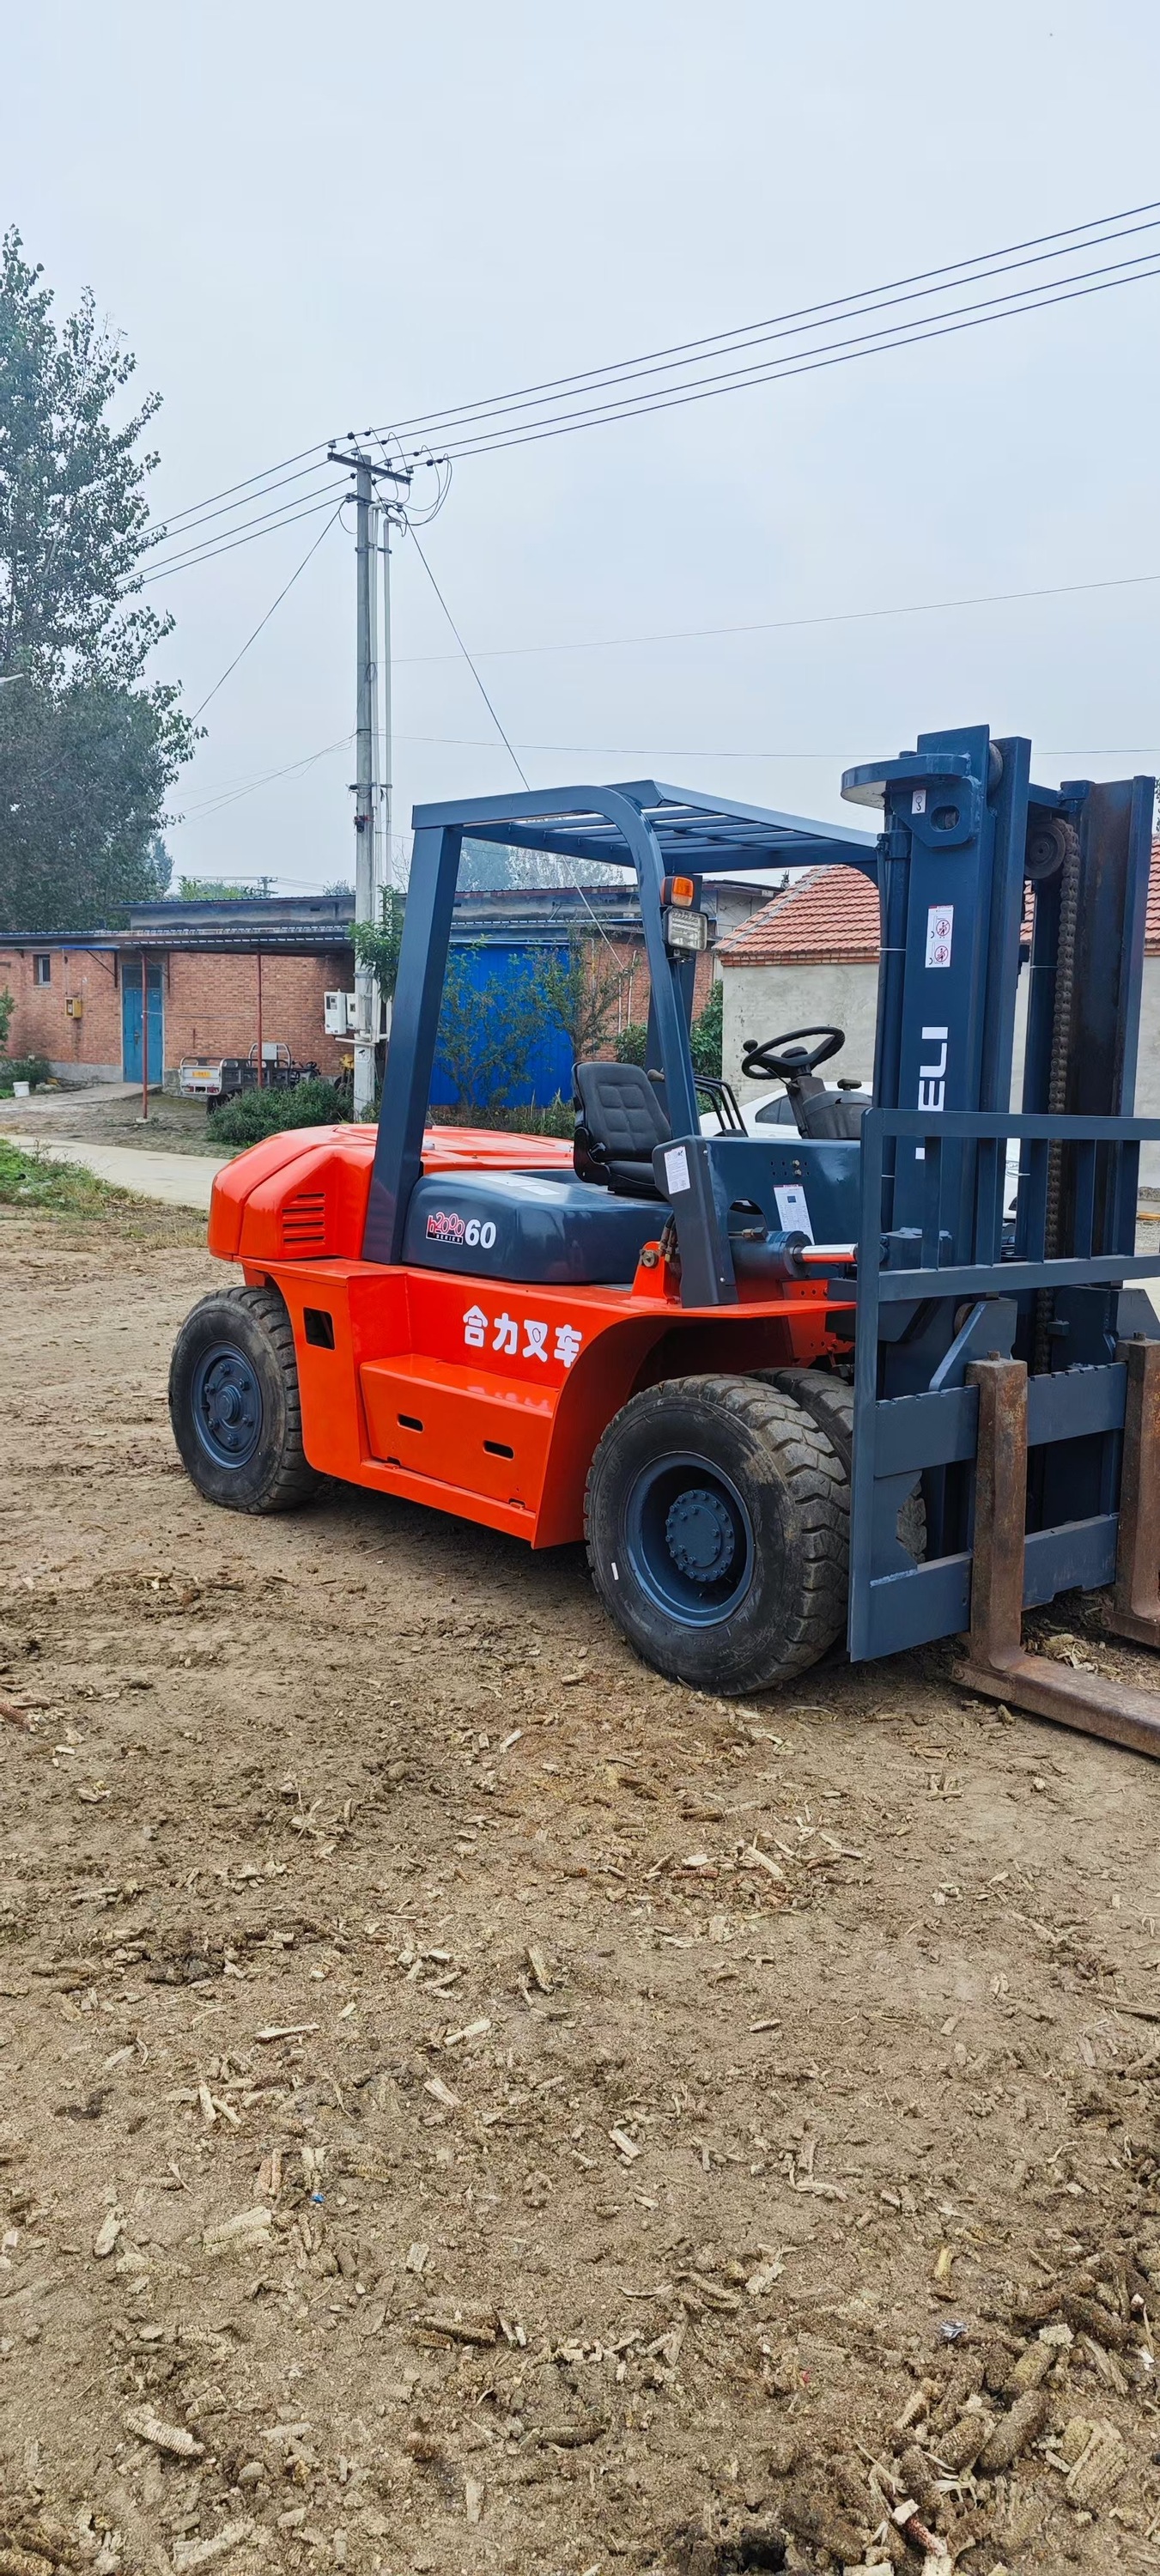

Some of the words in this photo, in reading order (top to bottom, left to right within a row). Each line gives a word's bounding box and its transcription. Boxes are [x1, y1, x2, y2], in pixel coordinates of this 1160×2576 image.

[915, 1026, 948, 1159] ELI
[465, 1219, 496, 1249] 60
[463, 1305, 582, 1368] 合力叉车
